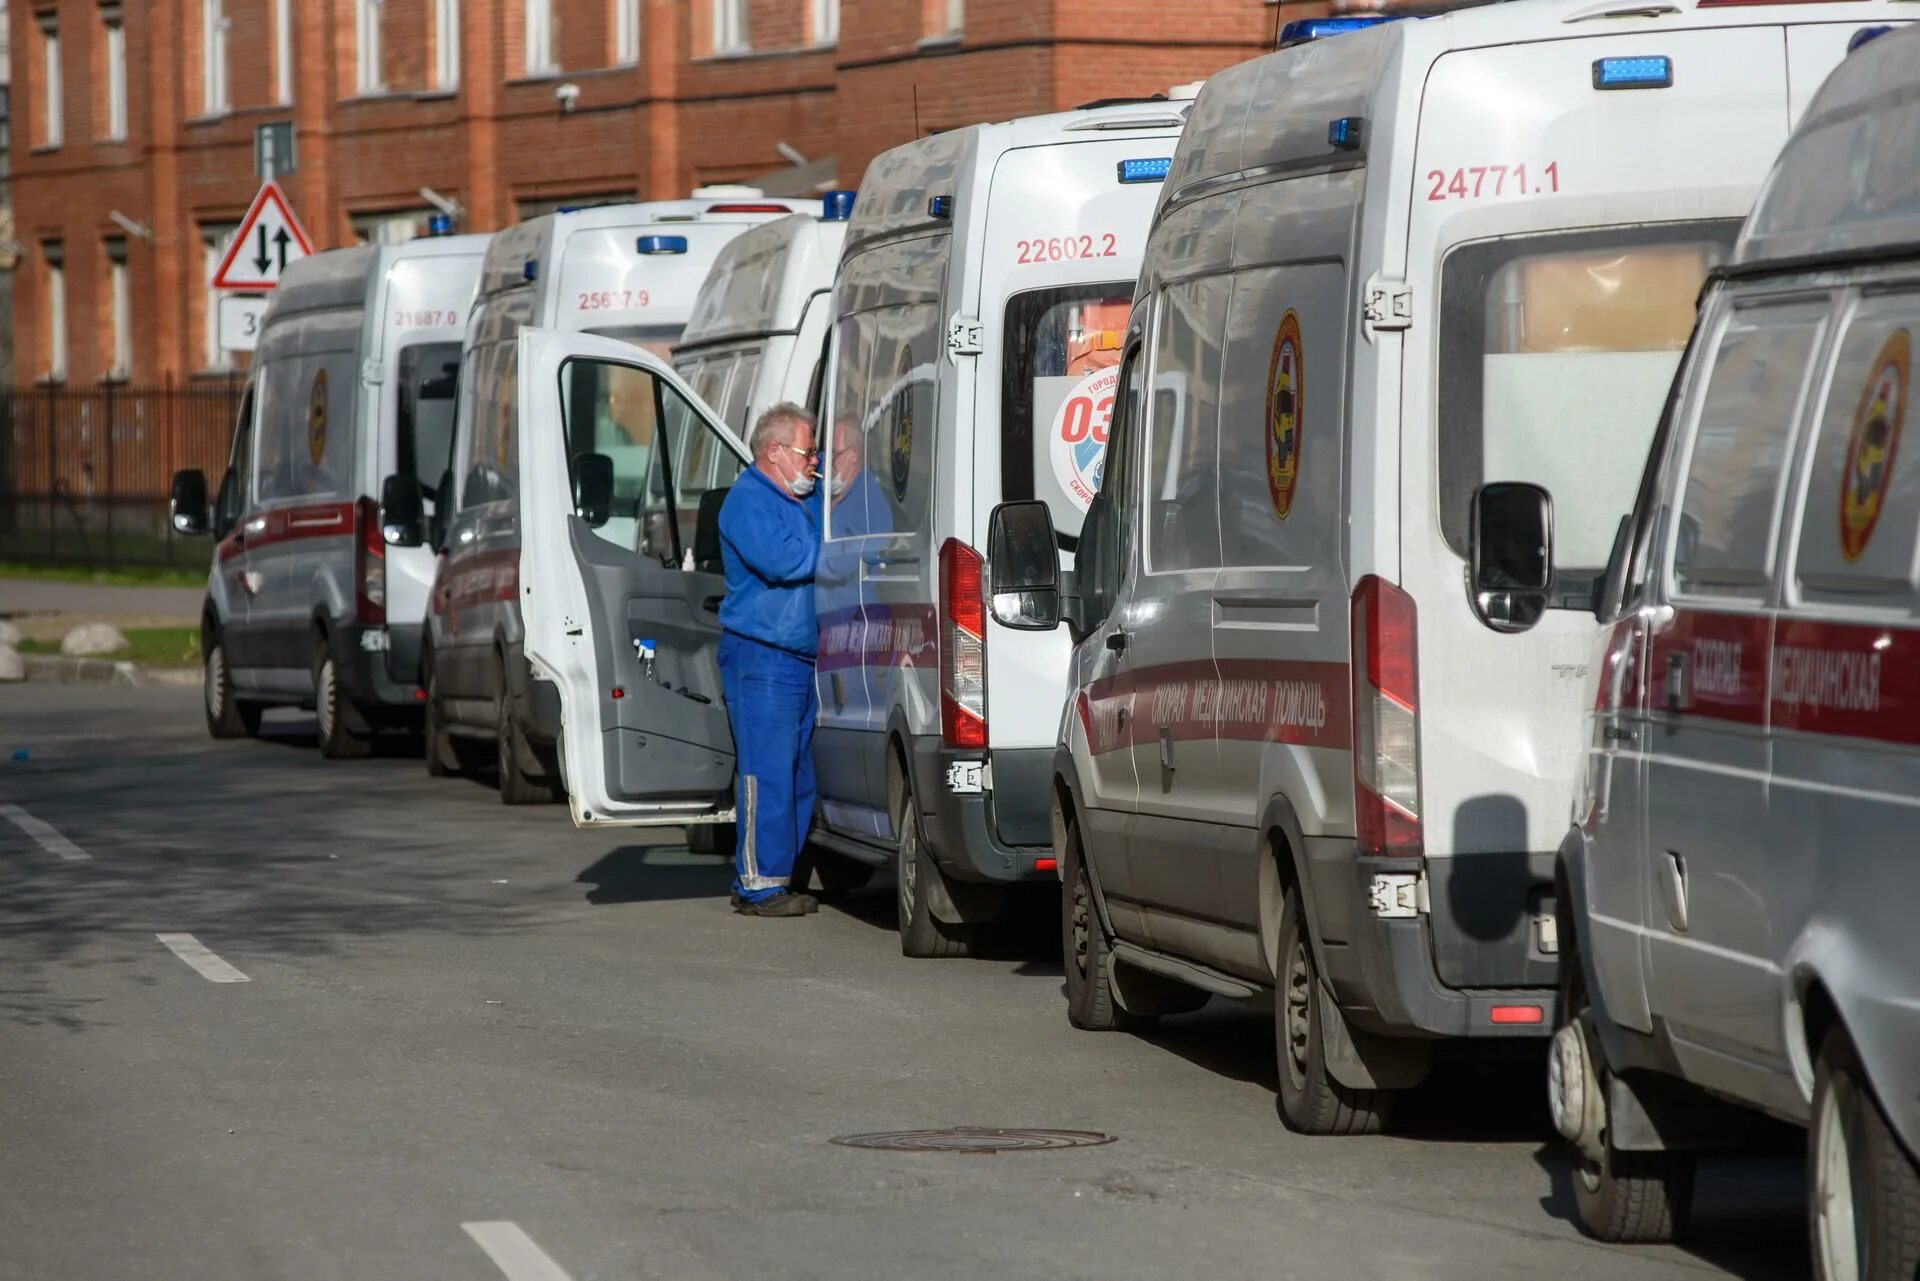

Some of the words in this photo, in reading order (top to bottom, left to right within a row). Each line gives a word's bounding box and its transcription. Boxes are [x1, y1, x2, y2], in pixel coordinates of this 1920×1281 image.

[1427, 161, 1559, 200] 24771.1
[1016, 233, 1117, 264] 22602.2
[1061, 396, 1114, 443] 03
[1070, 479, 1093, 505] СКОРО
[1152, 682, 1187, 725] СКОРАЯ
[1191, 680, 1267, 729] МЕДИЦИНСКАЯ
[1272, 680, 1325, 736] ПОМОЩЬ
